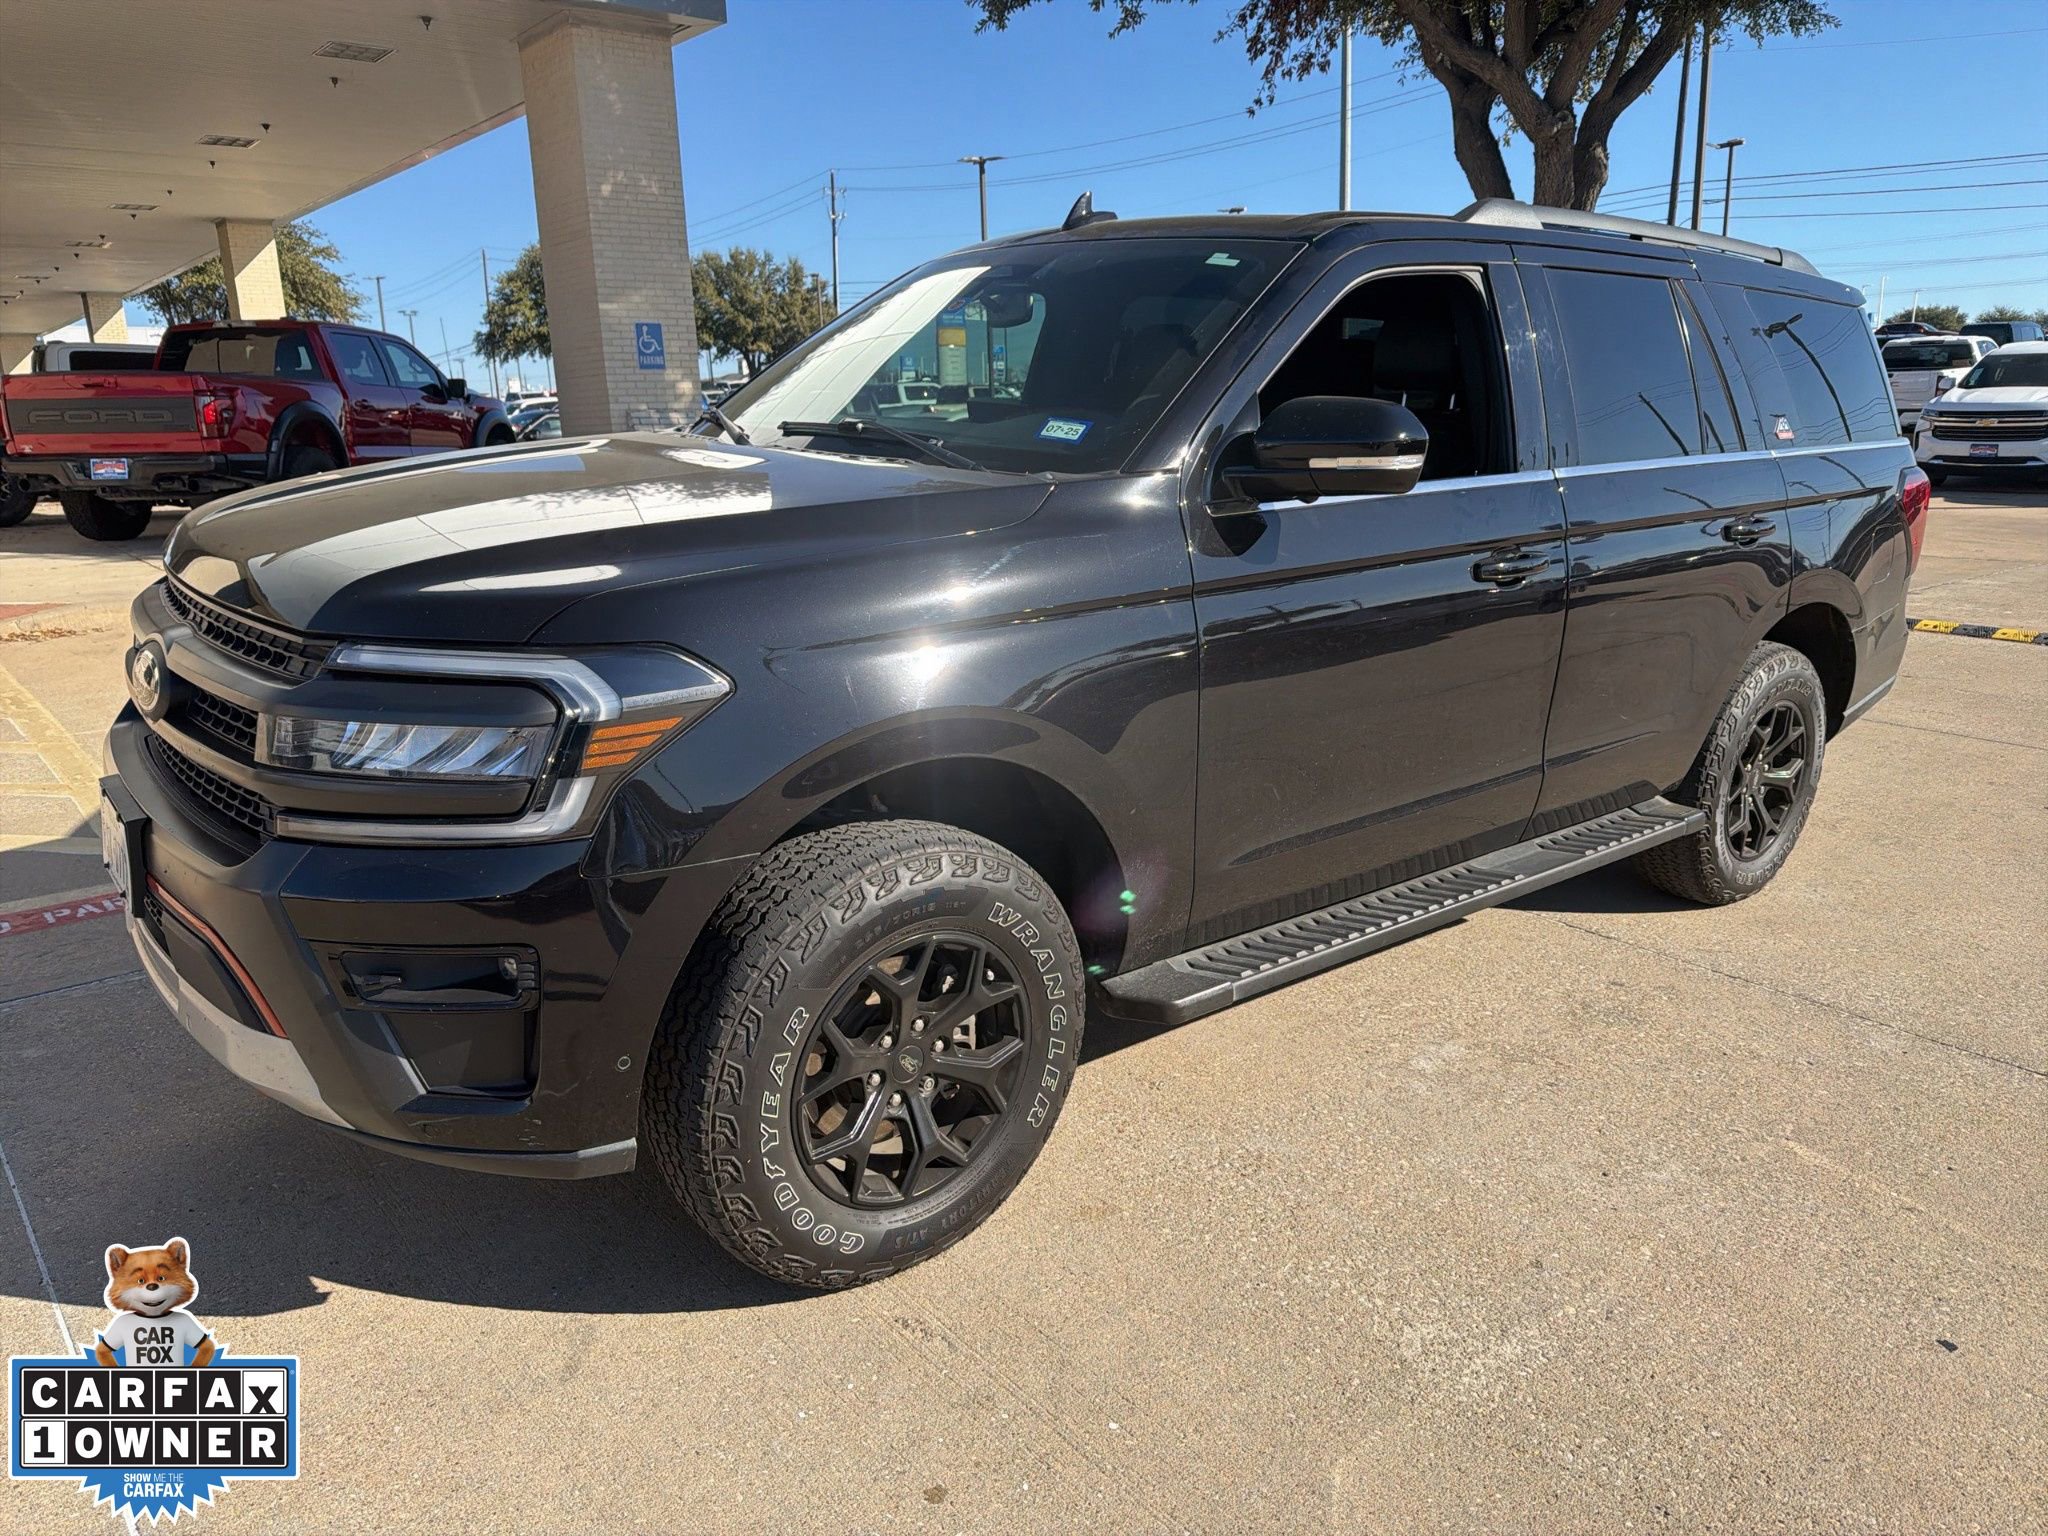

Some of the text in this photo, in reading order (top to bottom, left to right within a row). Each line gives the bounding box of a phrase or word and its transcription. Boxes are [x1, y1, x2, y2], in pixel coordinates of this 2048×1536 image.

[27, 410, 173, 424] FORD
[989, 902, 1067, 1128] WRANGLER
[760, 1006, 865, 1255] GOODYEAR
